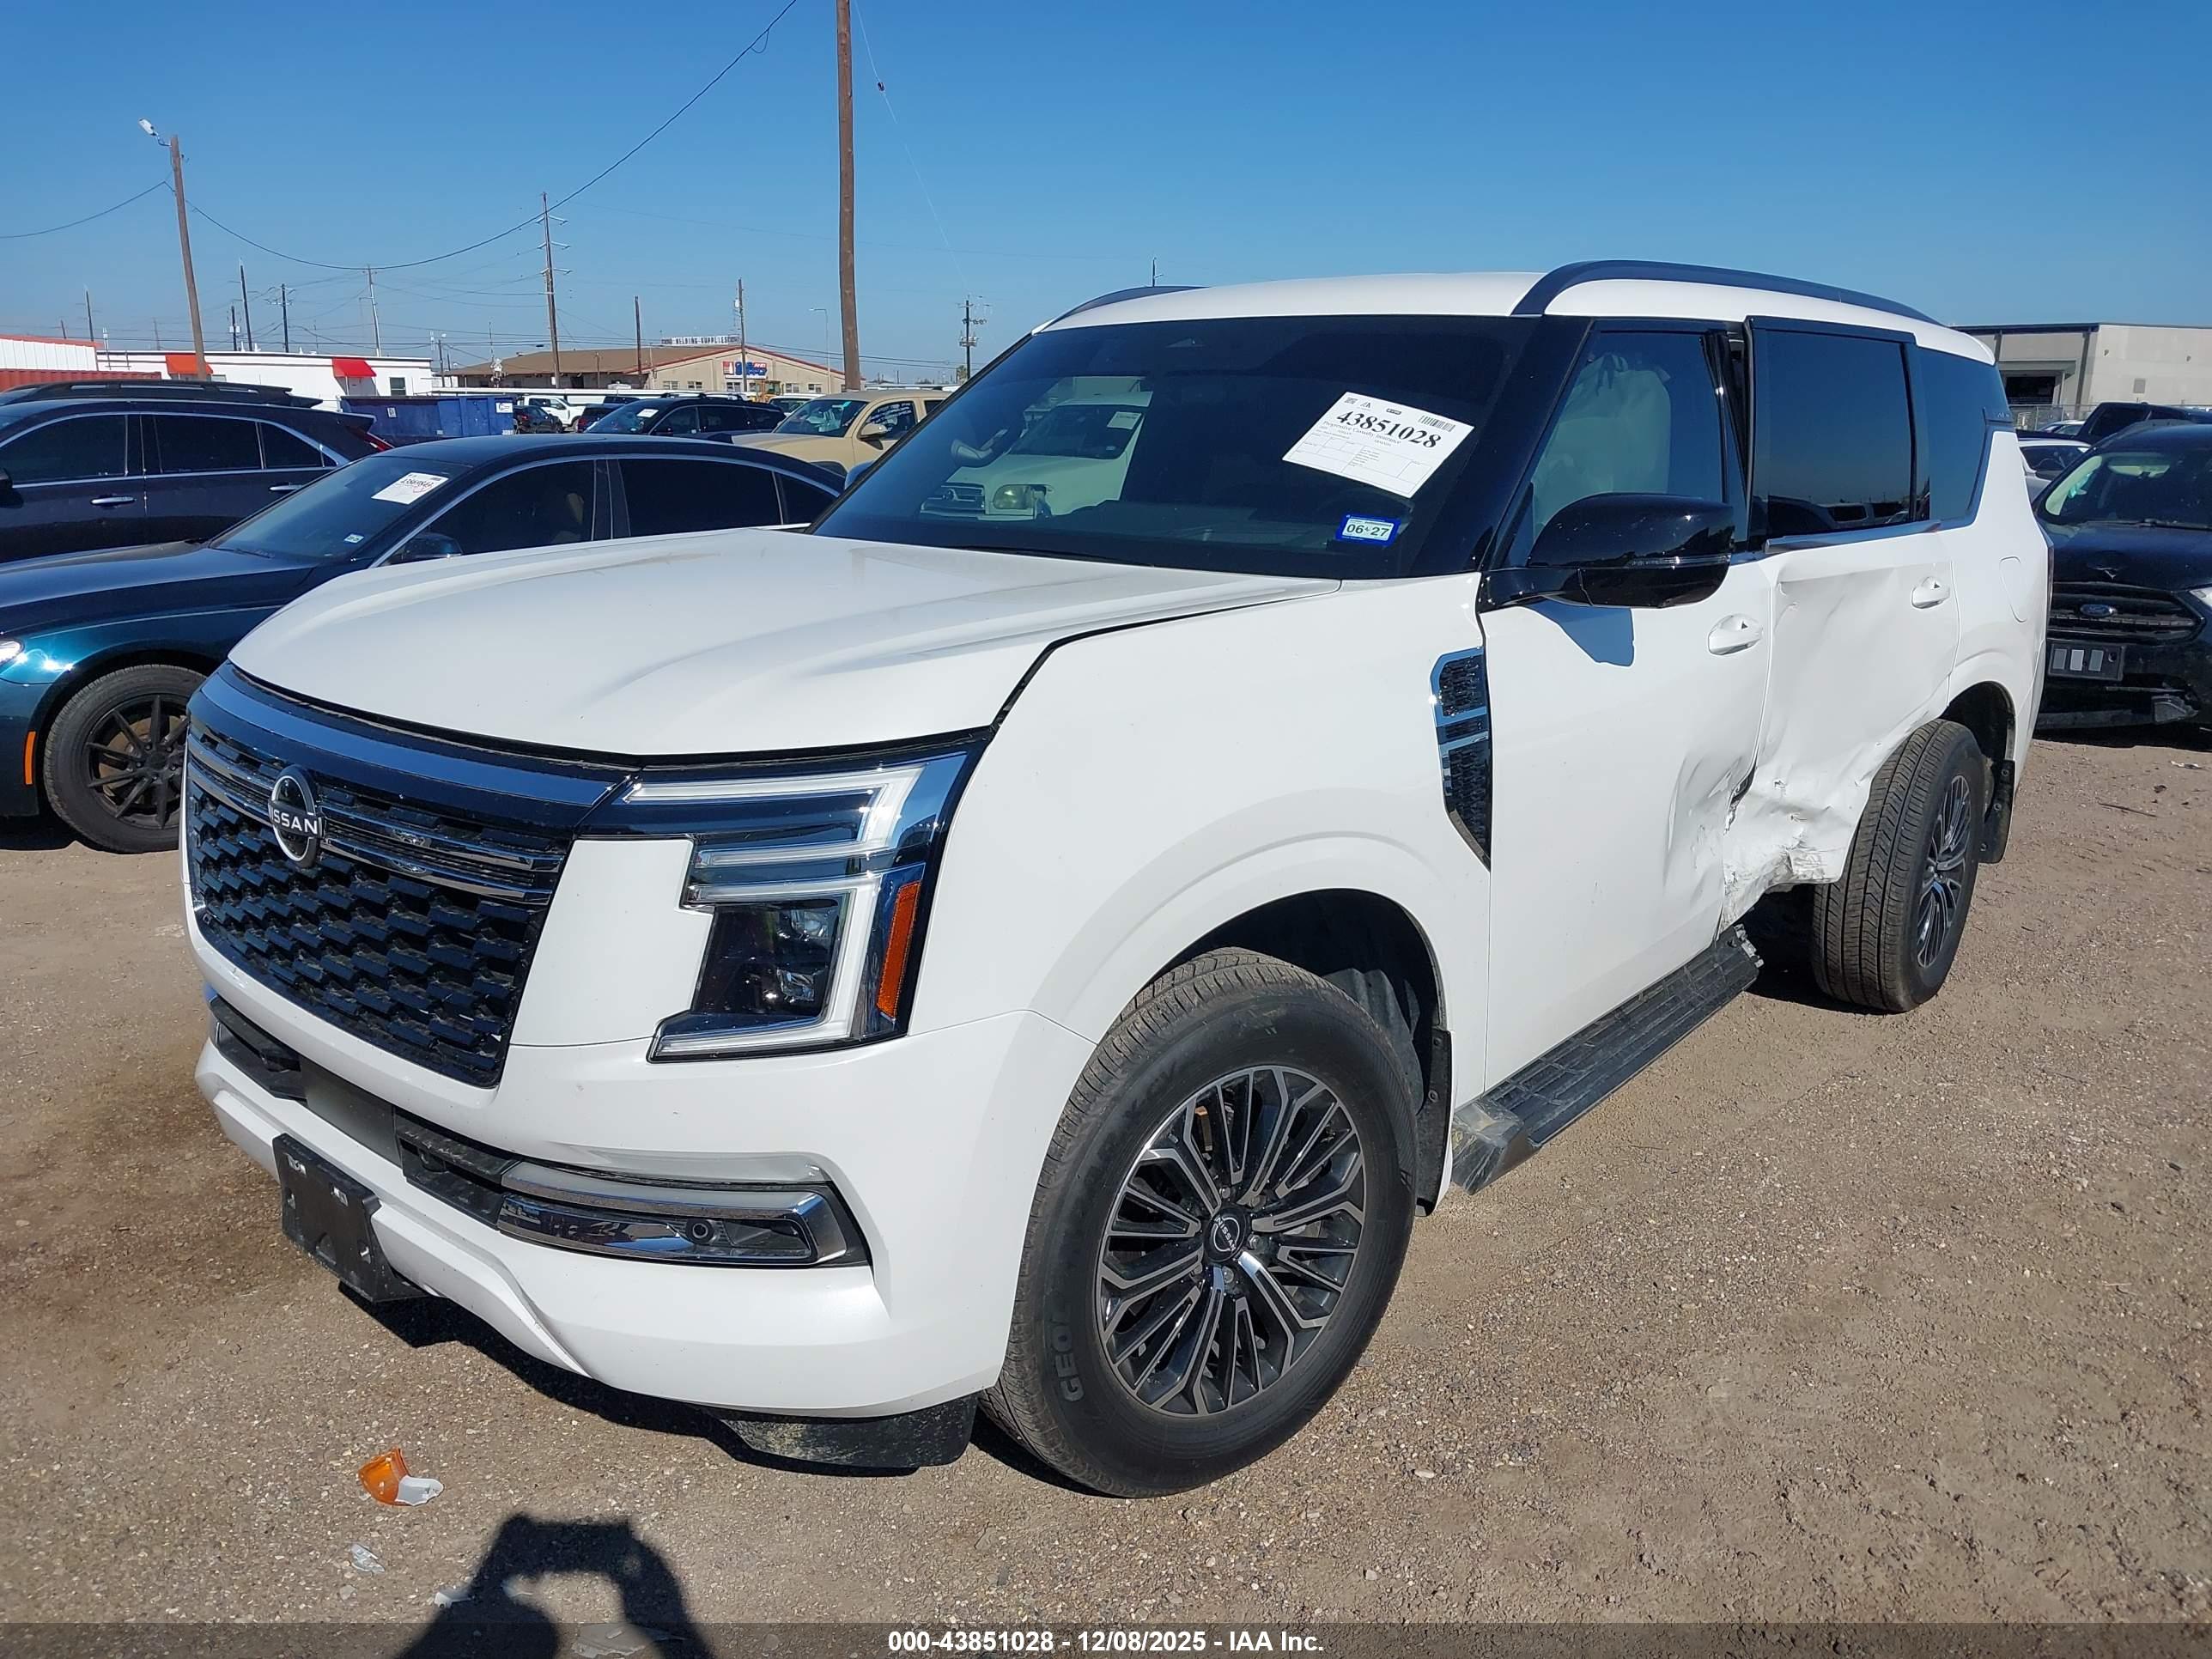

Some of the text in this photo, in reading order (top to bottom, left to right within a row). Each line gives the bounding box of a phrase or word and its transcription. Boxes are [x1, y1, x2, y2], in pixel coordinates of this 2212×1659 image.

[1337, 410, 1442, 448] 43851028
[1346, 524, 1390, 537] 06 27
[1213, 1215, 1237, 1252] NISSAN
